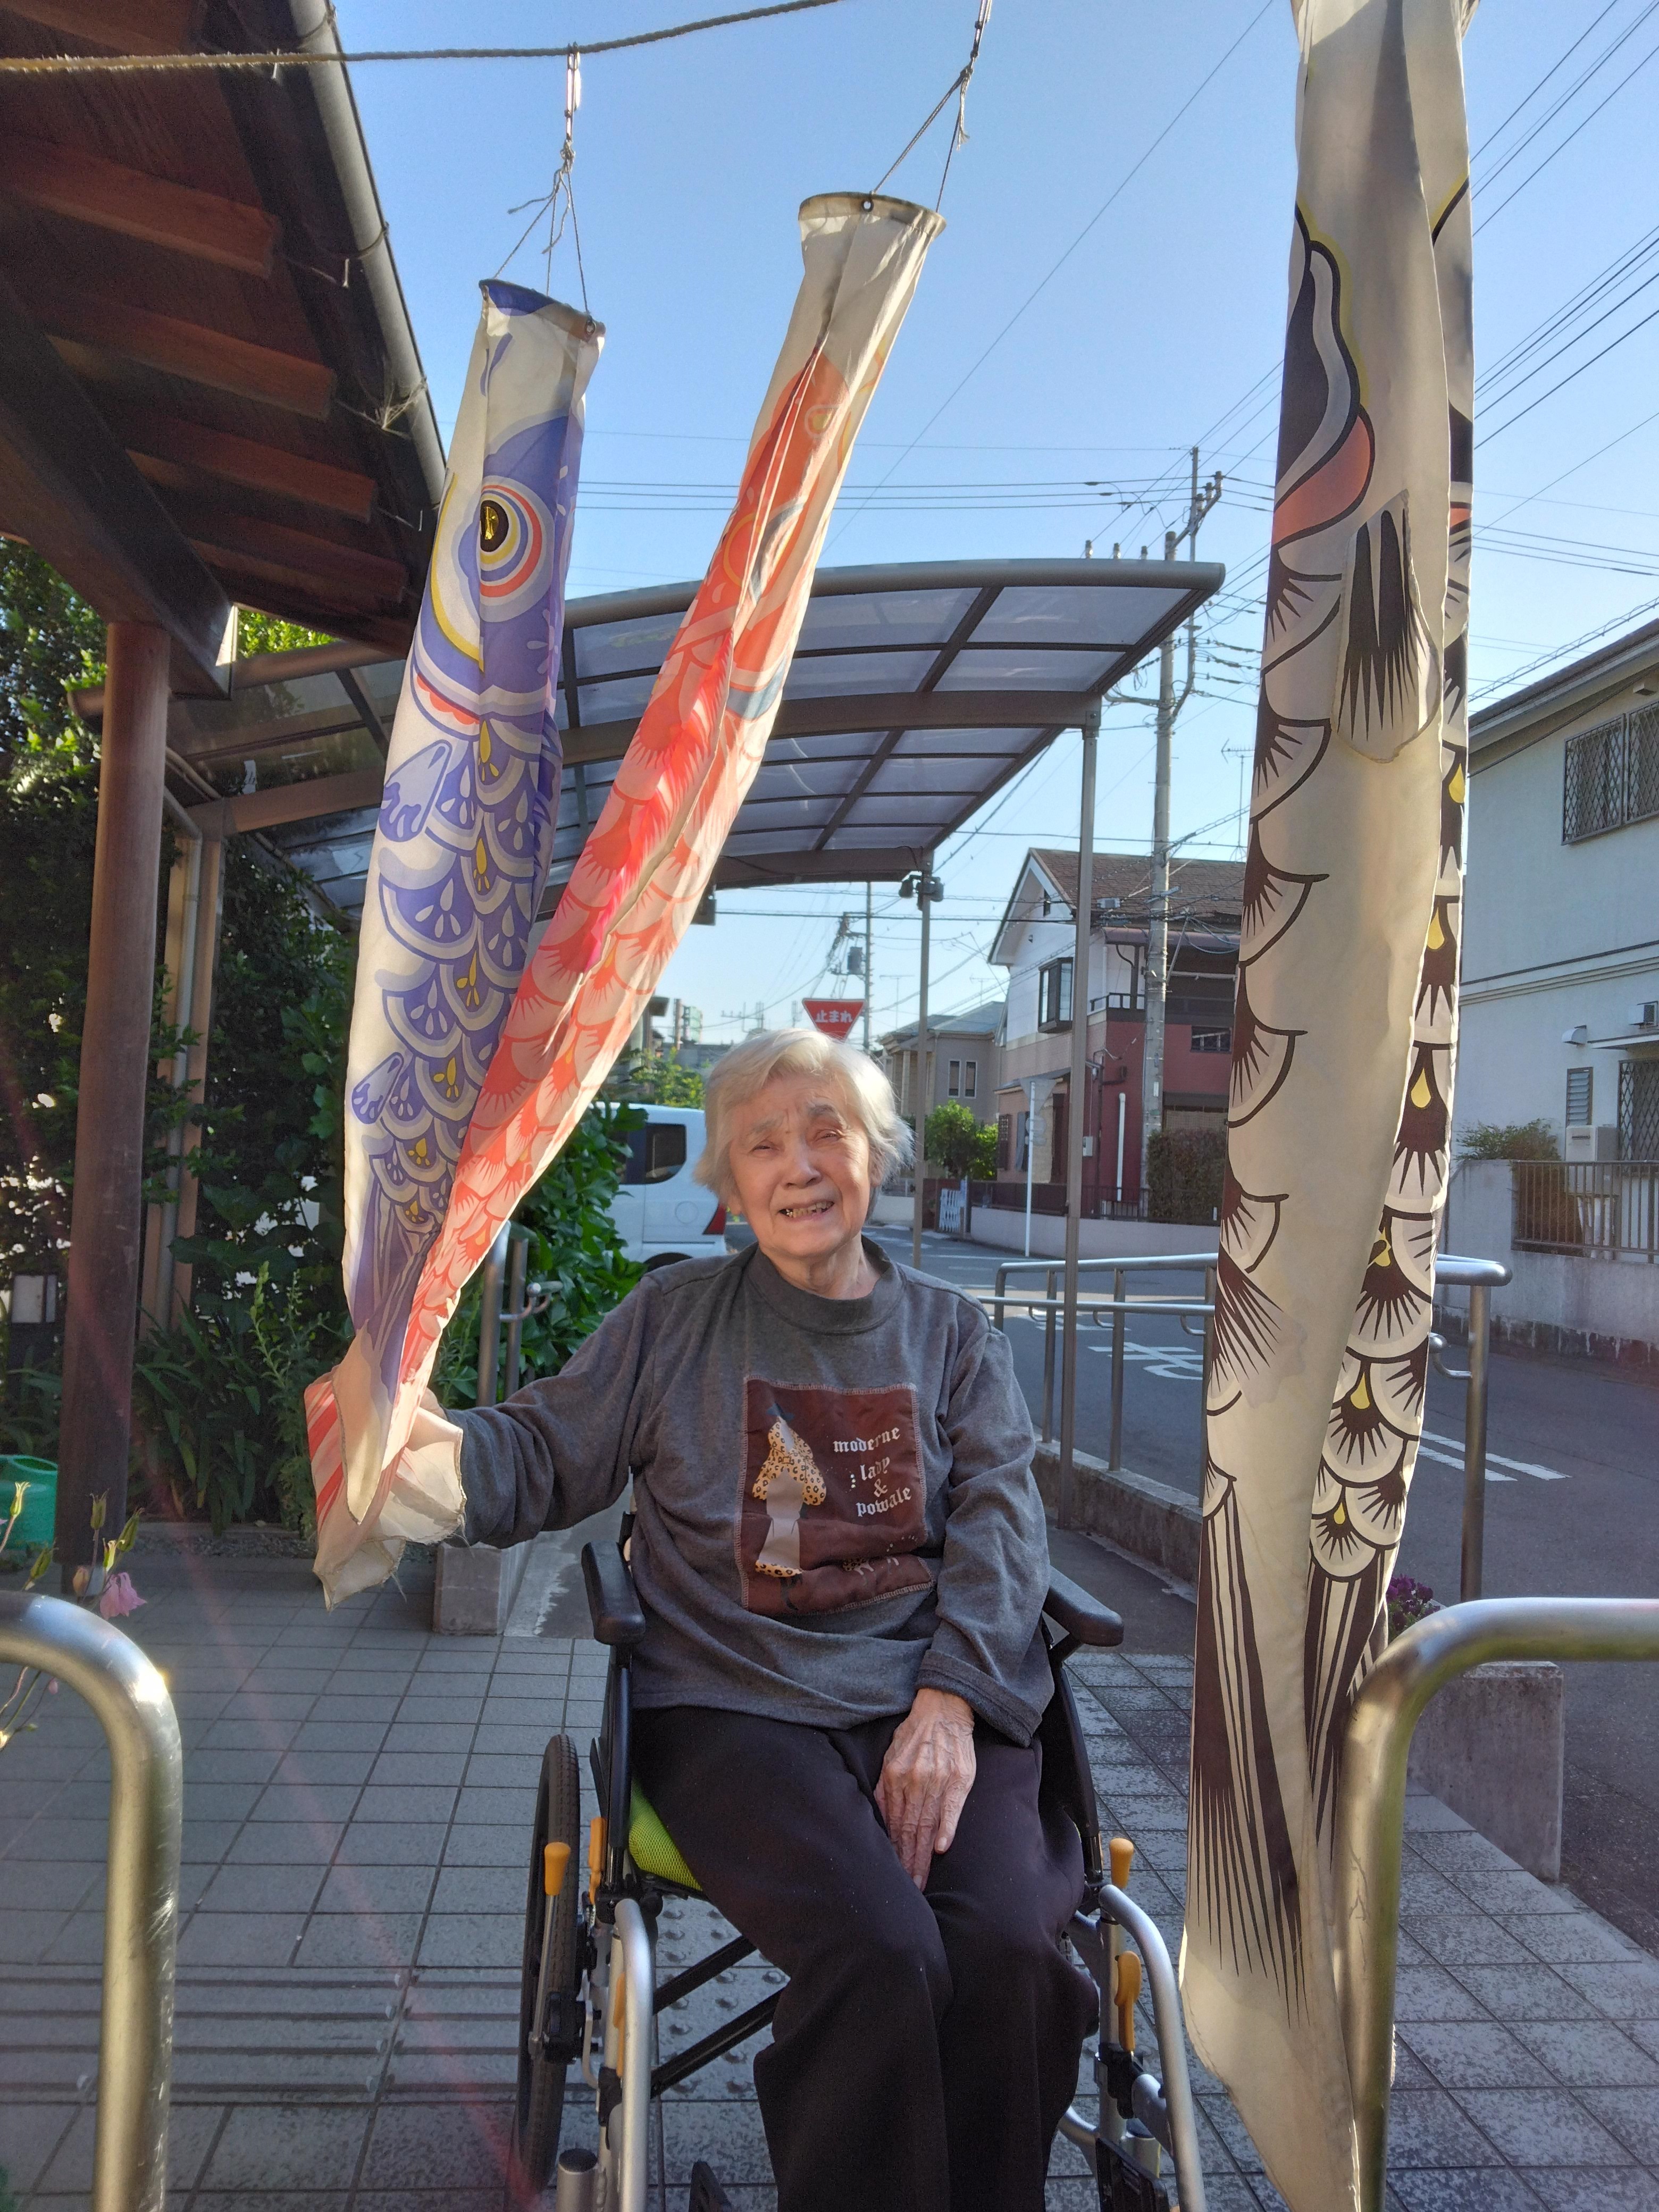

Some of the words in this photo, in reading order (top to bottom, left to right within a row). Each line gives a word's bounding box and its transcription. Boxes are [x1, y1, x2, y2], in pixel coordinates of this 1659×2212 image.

[815, 1010, 853, 1023] 止まれ
[833, 1427, 900, 1452] moderne
[860, 1457, 890, 1481] lady
[874, 1478, 888, 1497] &
